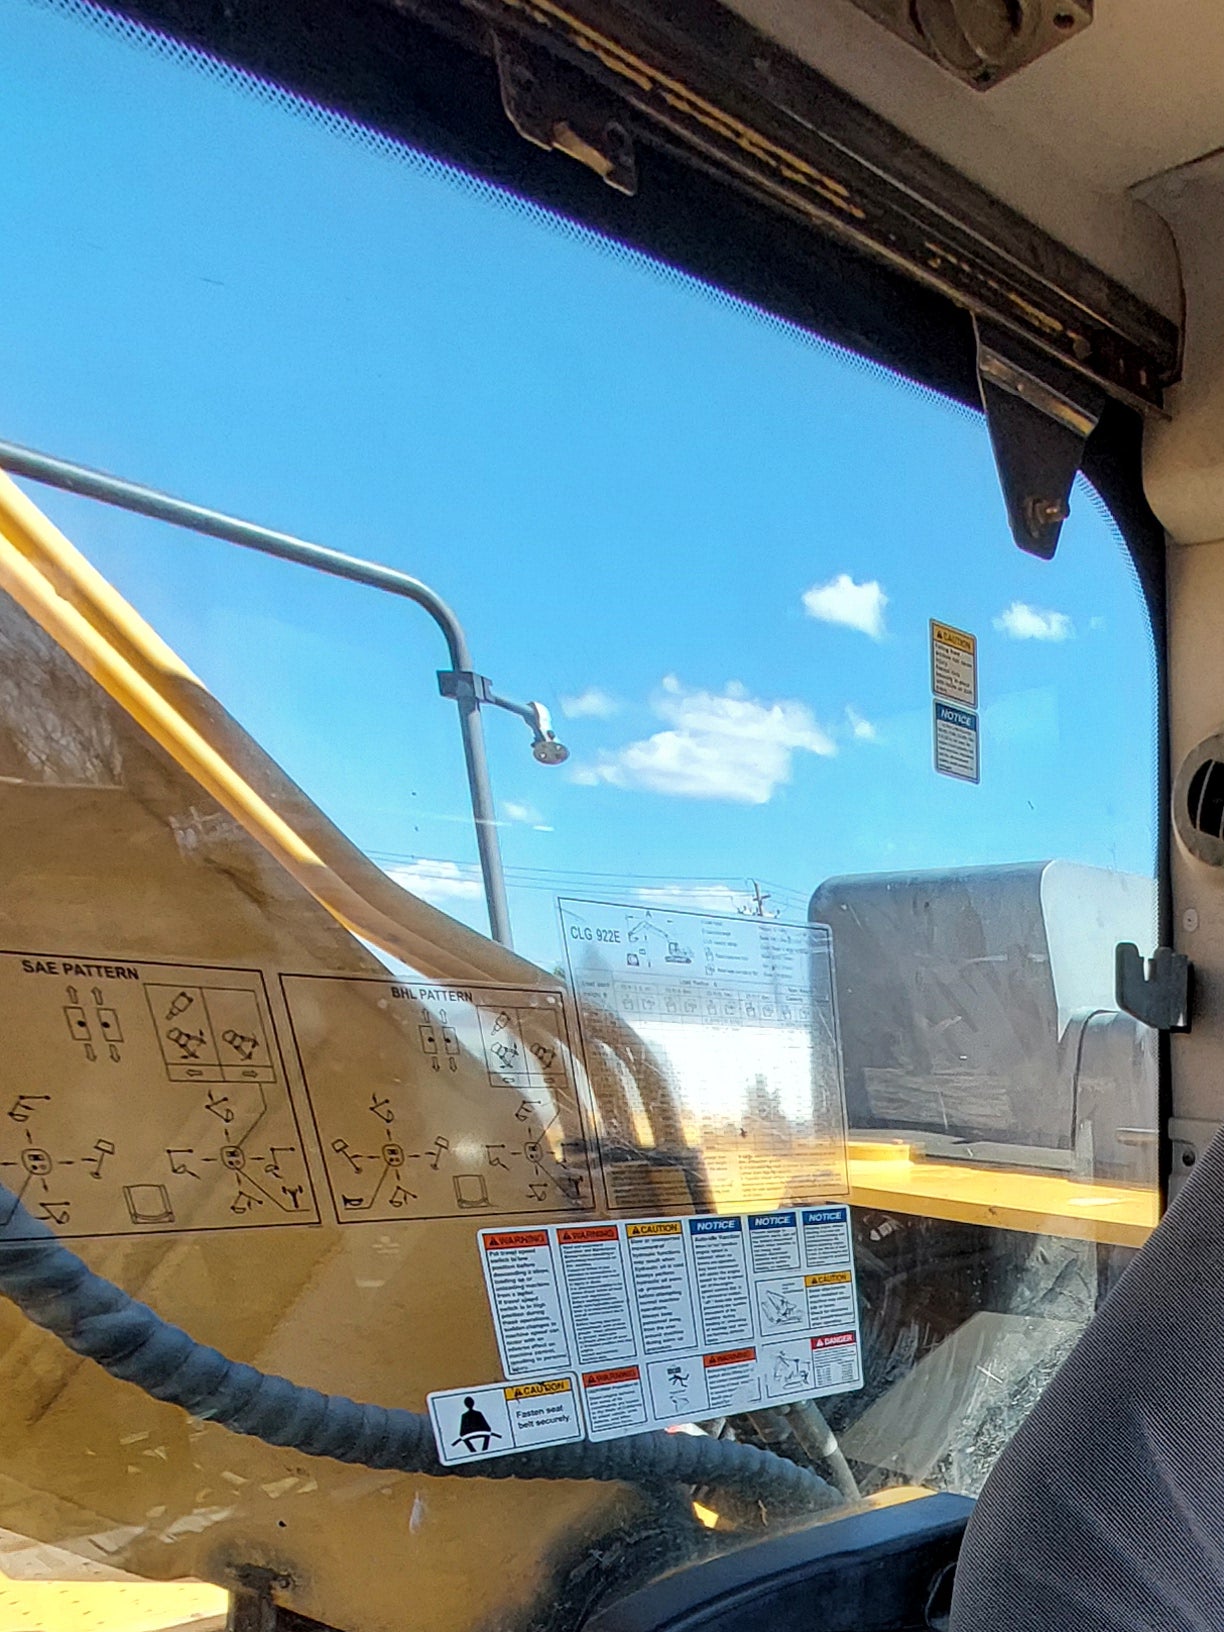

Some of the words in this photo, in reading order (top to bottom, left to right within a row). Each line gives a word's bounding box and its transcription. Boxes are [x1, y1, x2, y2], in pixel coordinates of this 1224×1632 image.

[944, 631, 971, 649] CAUTION
[941, 709, 971, 726] NOTICE
[570, 926, 593, 941] CLG
[596, 927, 621, 944] 922E
[21, 959, 58, 975] SAE
[62, 963, 140, 980] PATTERN
[391, 986, 418, 1000] BHL
[419, 989, 473, 1002] PATTERN
[754, 1215, 791, 1226] NOTICE
[808, 1211, 842, 1222] NOTICE
[640, 1223, 678, 1234] CAUTION
[696, 1220, 736, 1231] NOTICE
[499, 1234, 545, 1245] WARNING
[571, 1229, 615, 1240] WARNING
[818, 1274, 847, 1284] CAUTION
[824, 1333, 853, 1346] DANGER
[596, 1368, 637, 1381] WARNING
[523, 1380, 565, 1396] CAUTION
[516, 1407, 545, 1419] Fasten
[546, 1404, 564, 1414] seat
[518, 1418, 535, 1430] belt
[536, 1414, 572, 1427] securely.
